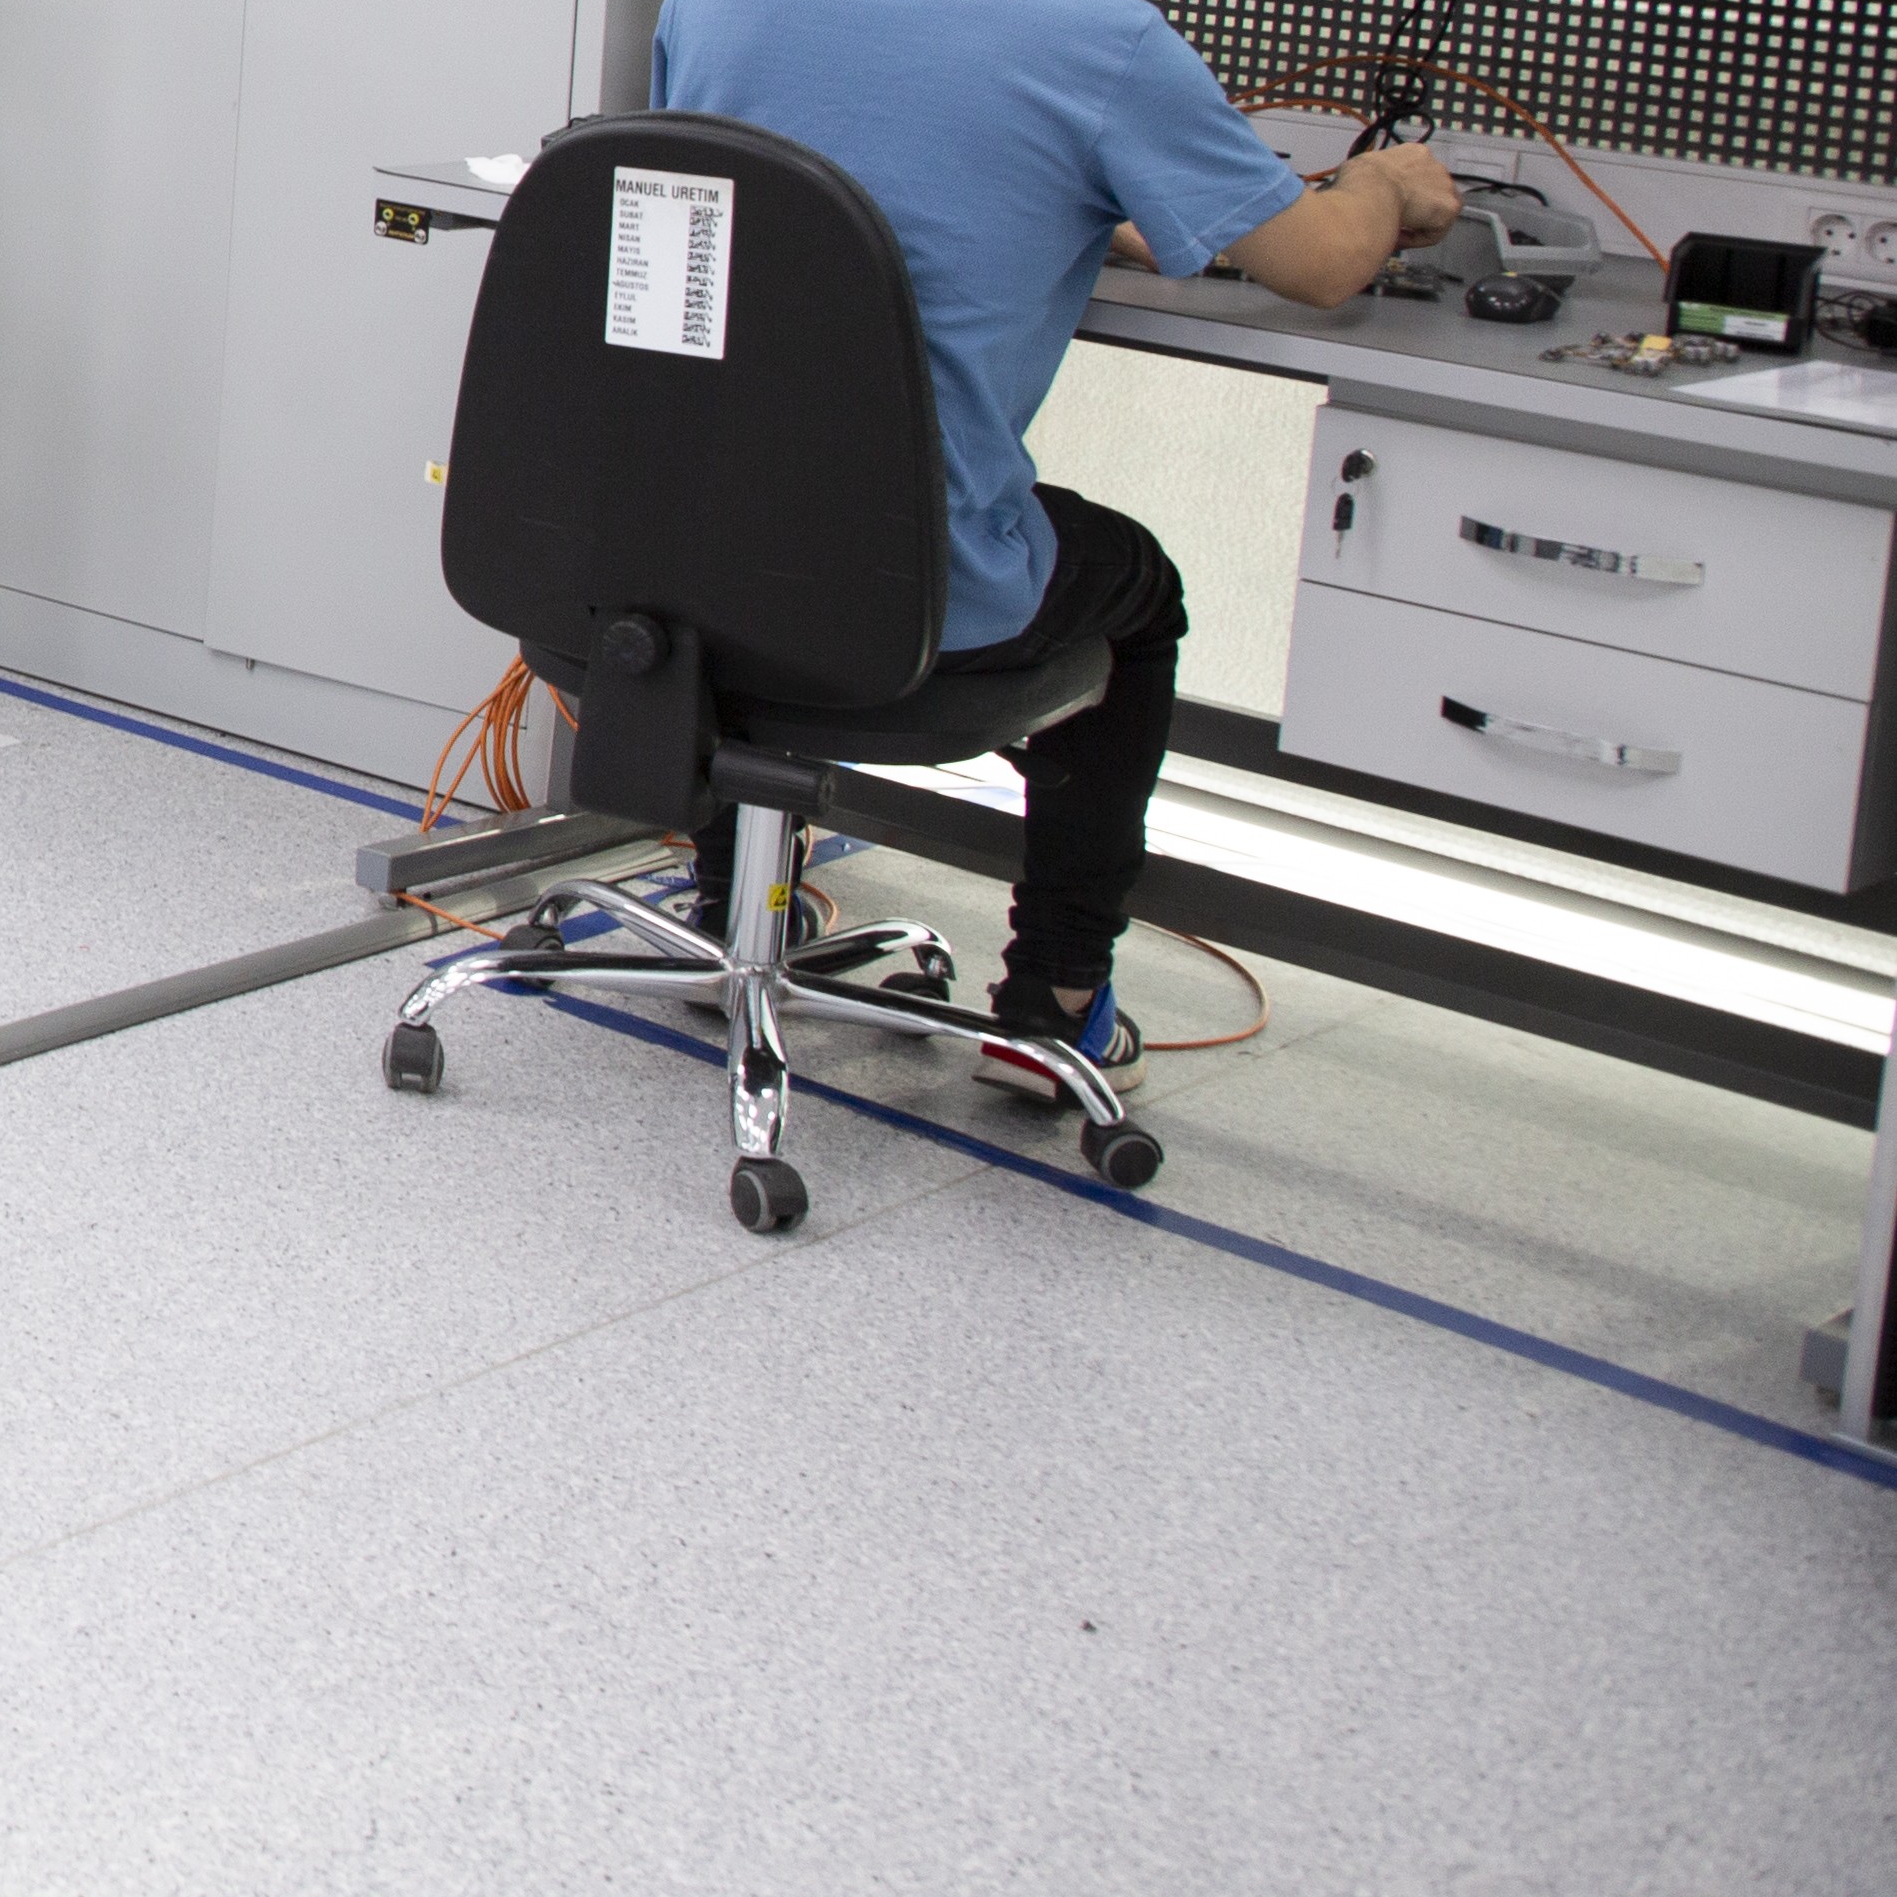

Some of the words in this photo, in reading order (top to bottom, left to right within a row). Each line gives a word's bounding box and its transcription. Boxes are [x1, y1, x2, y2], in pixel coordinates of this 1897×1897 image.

[615, 179, 667, 198] MANUEL
[670, 185, 720, 203] URETIM
[619, 198, 640, 208] OCAK
[619, 210, 644, 220] SUBAT
[618, 222, 640, 231] MART
[618, 234, 641, 243] NISAN
[617, 245, 641, 255] MAYIS
[616, 257, 649, 267] HAZIRAN
[616, 268, 648, 280] TEMMUZ
[613, 315, 636, 324] KASIM
[612, 326, 639, 337] ARALIK
